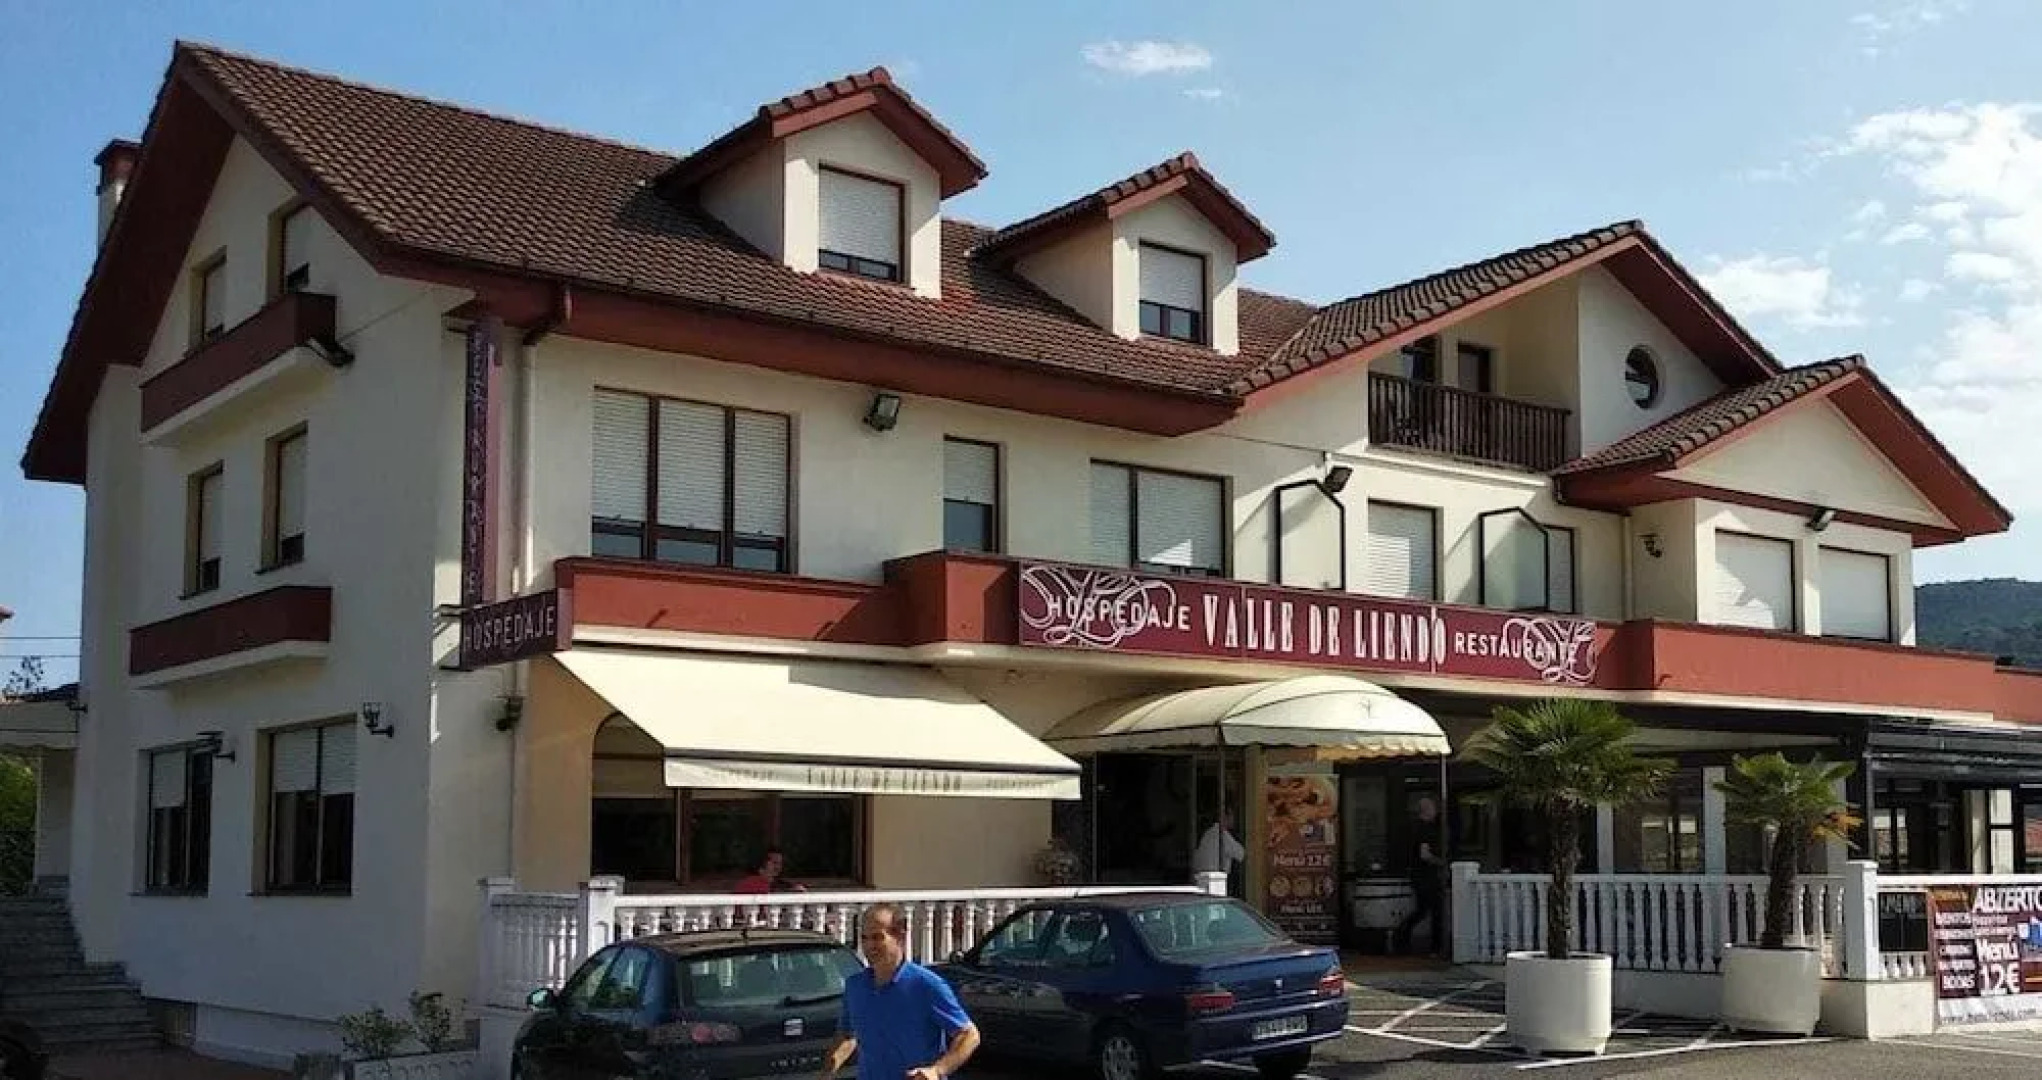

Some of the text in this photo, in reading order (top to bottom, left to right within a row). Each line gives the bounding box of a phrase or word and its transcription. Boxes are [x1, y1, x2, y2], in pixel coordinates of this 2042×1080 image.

[463, 605, 555, 652] HOSPEDAJE
[1049, 593, 1579, 665] HOSPEDAJE VALLE DE LIENDO RESTAURANTE
[1975, 933, 2020, 962] Menú
[1979, 962, 2021, 994] 12€
